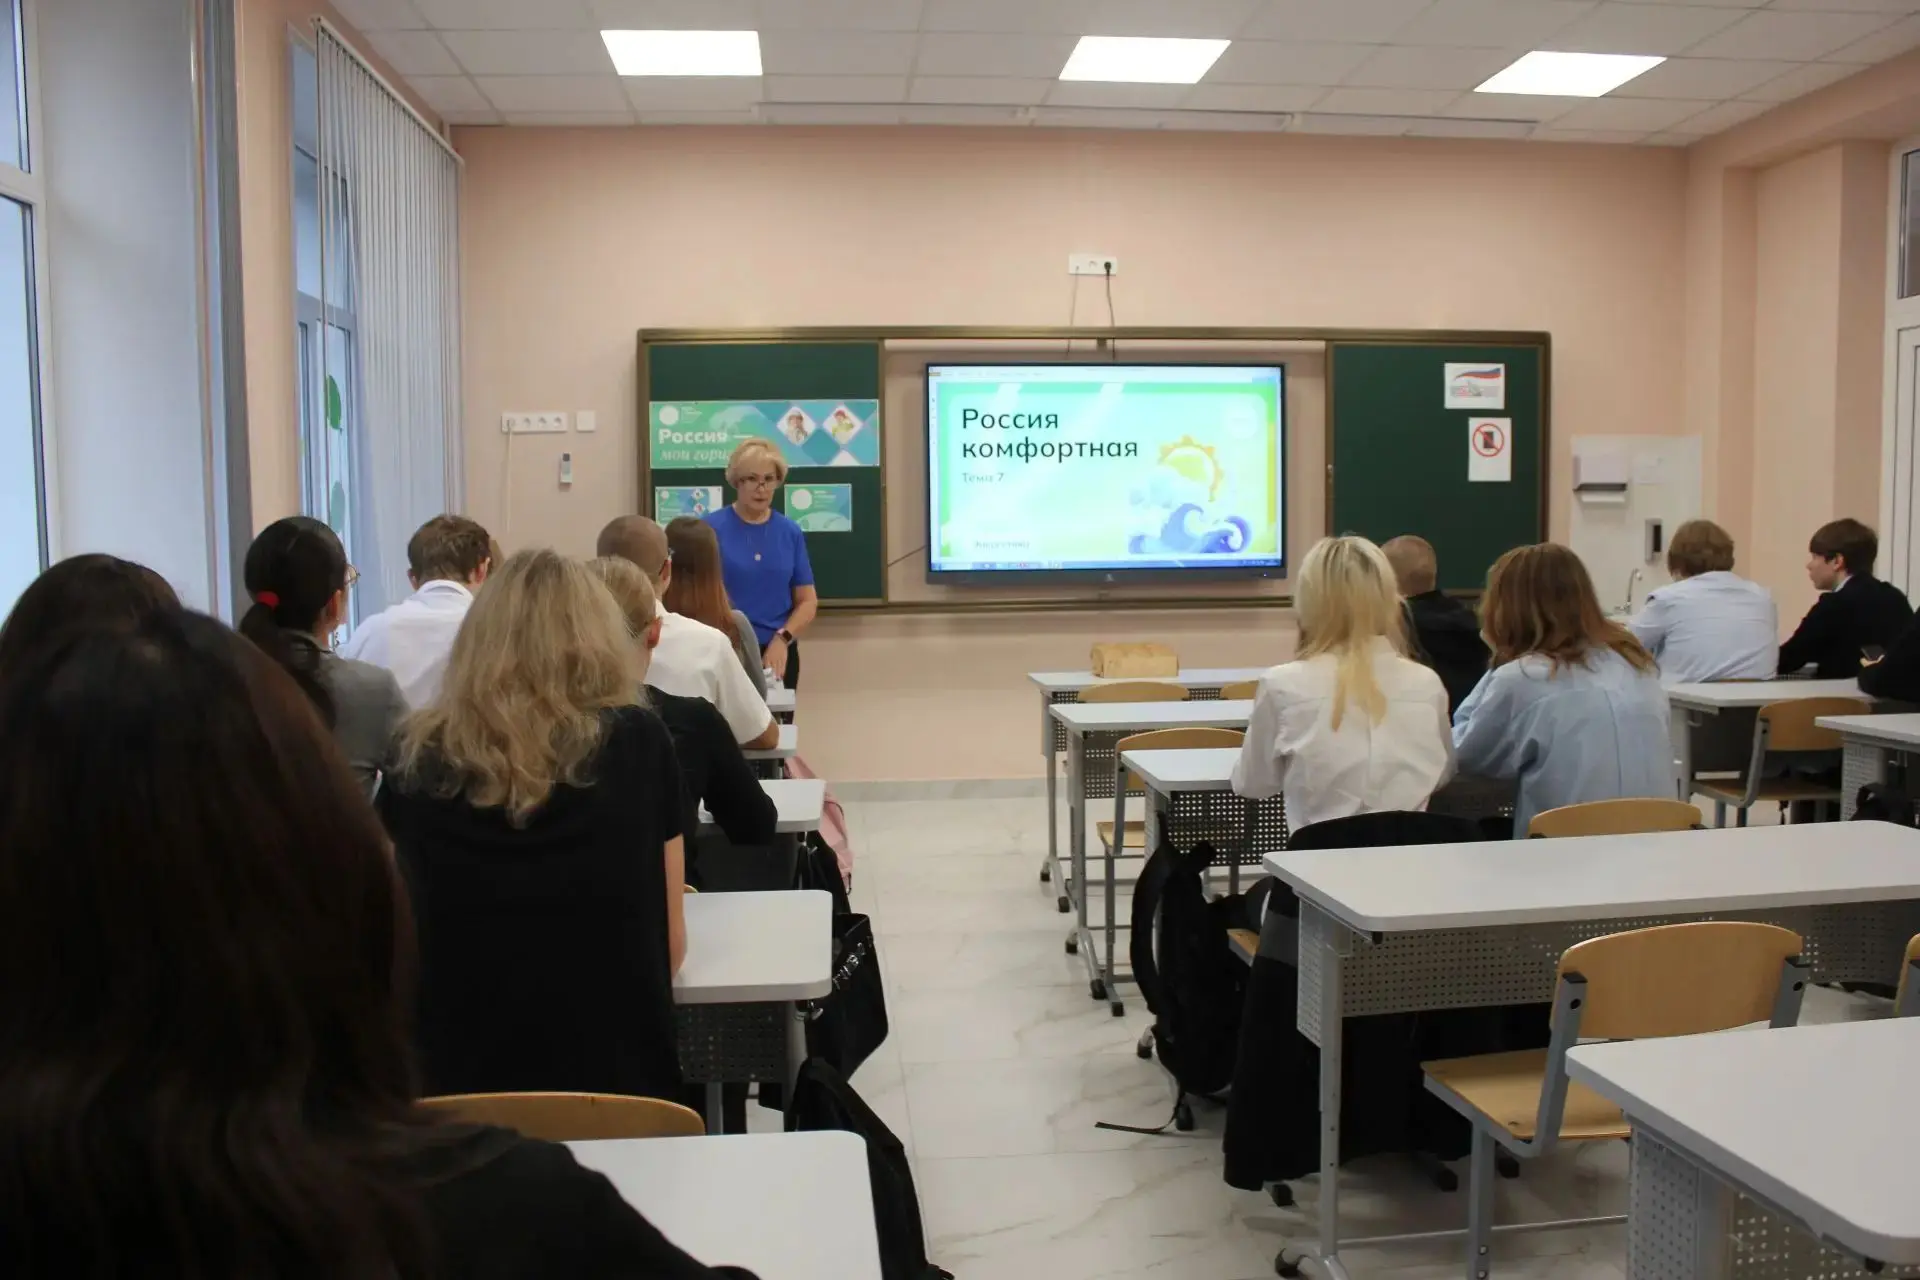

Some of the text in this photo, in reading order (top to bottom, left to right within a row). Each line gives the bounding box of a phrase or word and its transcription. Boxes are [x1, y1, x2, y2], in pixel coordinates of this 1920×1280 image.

[962, 408, 1059, 430] Россия
[659, 428, 728, 444] Россия
[661, 449, 690, 461] мои
[962, 436, 1138, 464] комфортная
[961, 472, 1005, 484] Тема 7
